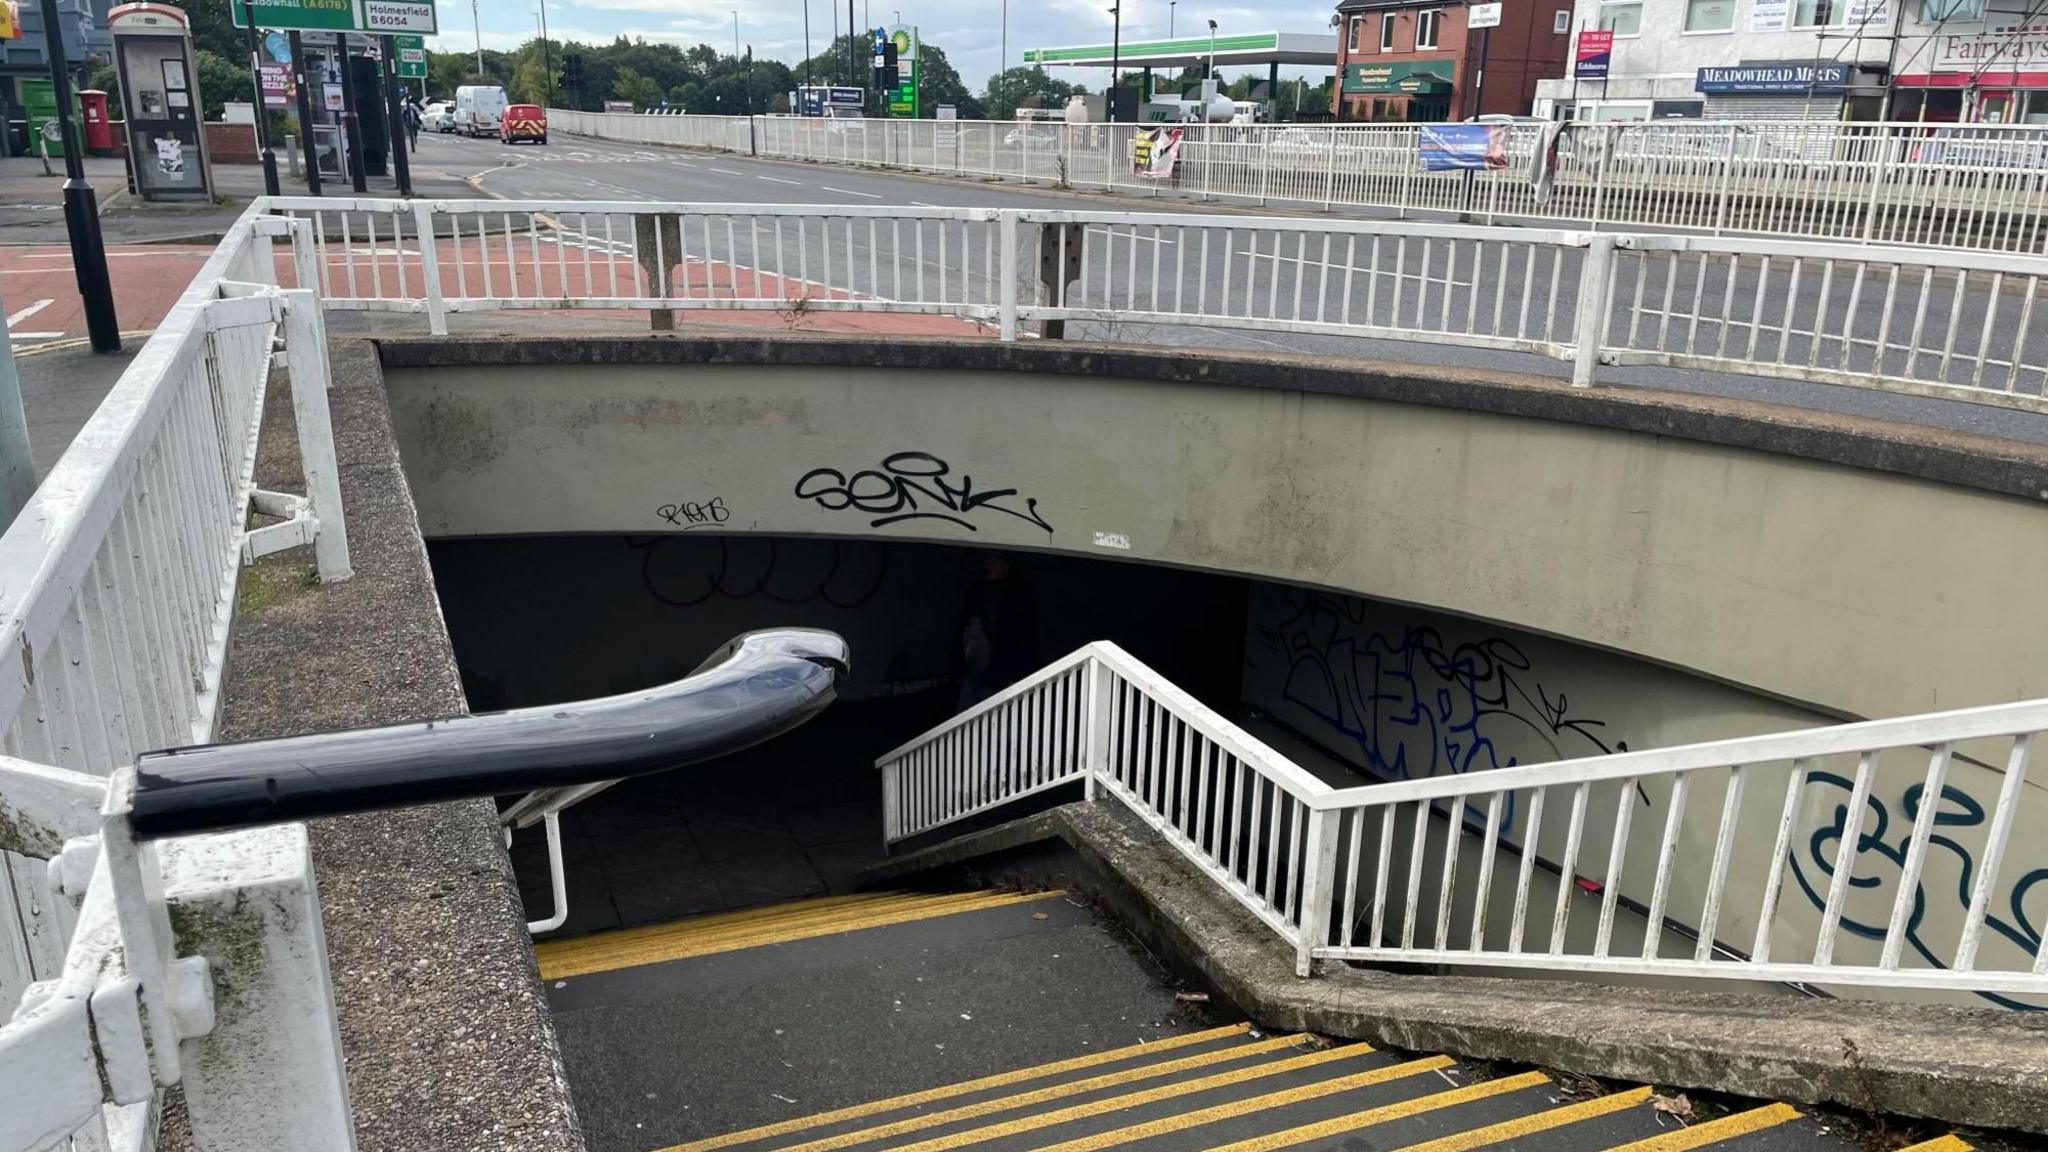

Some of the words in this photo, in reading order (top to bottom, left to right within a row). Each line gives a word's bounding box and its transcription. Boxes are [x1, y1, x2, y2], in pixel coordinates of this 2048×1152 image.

[370, 5, 429, 16] Holmesfield
[1702, 68, 1793, 83] MEADOWHEAD
[1795, 66, 1841, 81] MEATS
